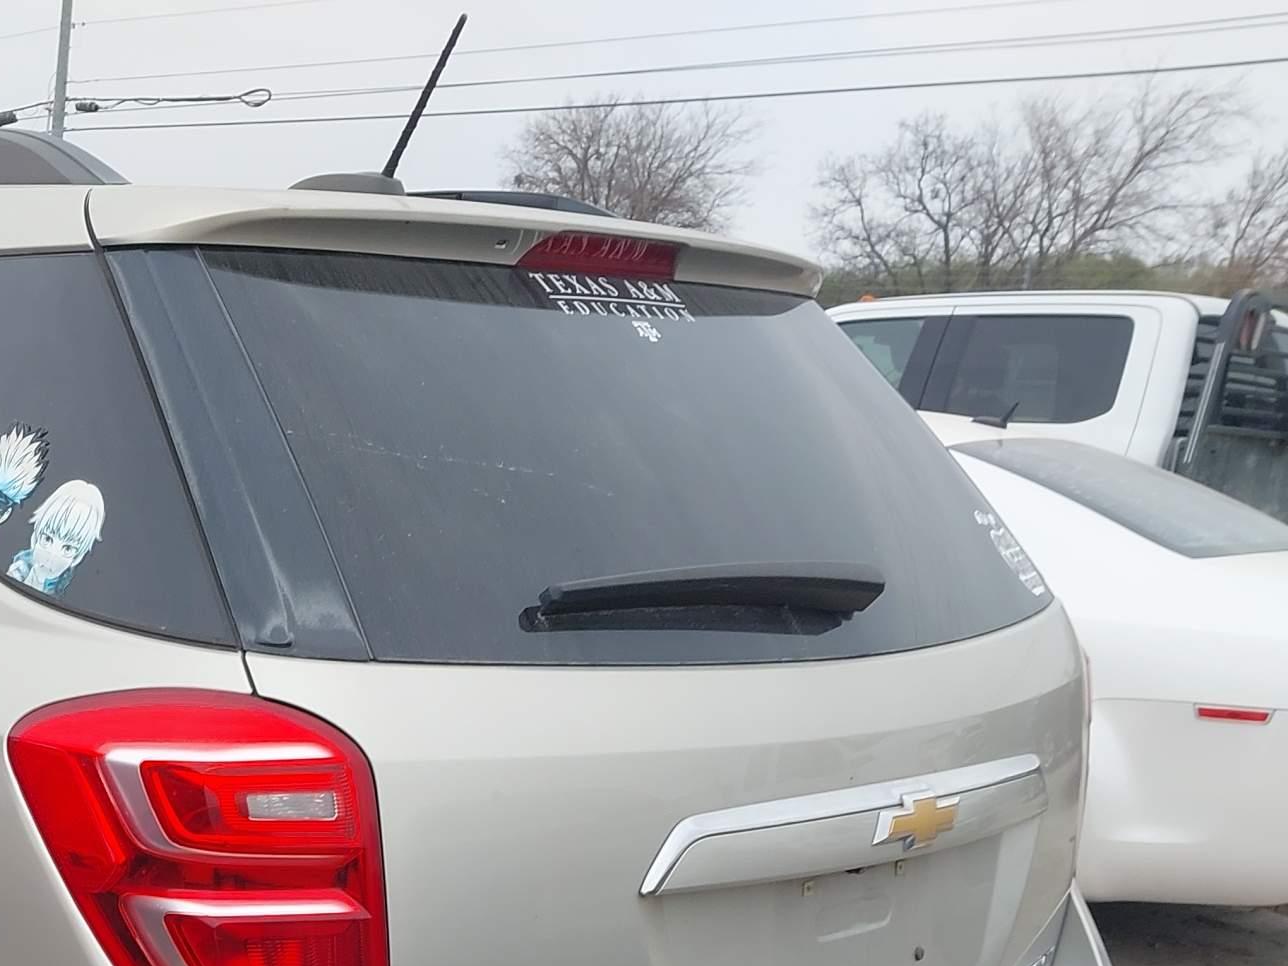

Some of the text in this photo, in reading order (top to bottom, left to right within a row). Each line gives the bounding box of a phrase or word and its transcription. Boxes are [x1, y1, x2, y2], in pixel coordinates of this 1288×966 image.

[528, 272, 682, 303] TEXAS A&M
[557, 300, 696, 323] EDUCATION
